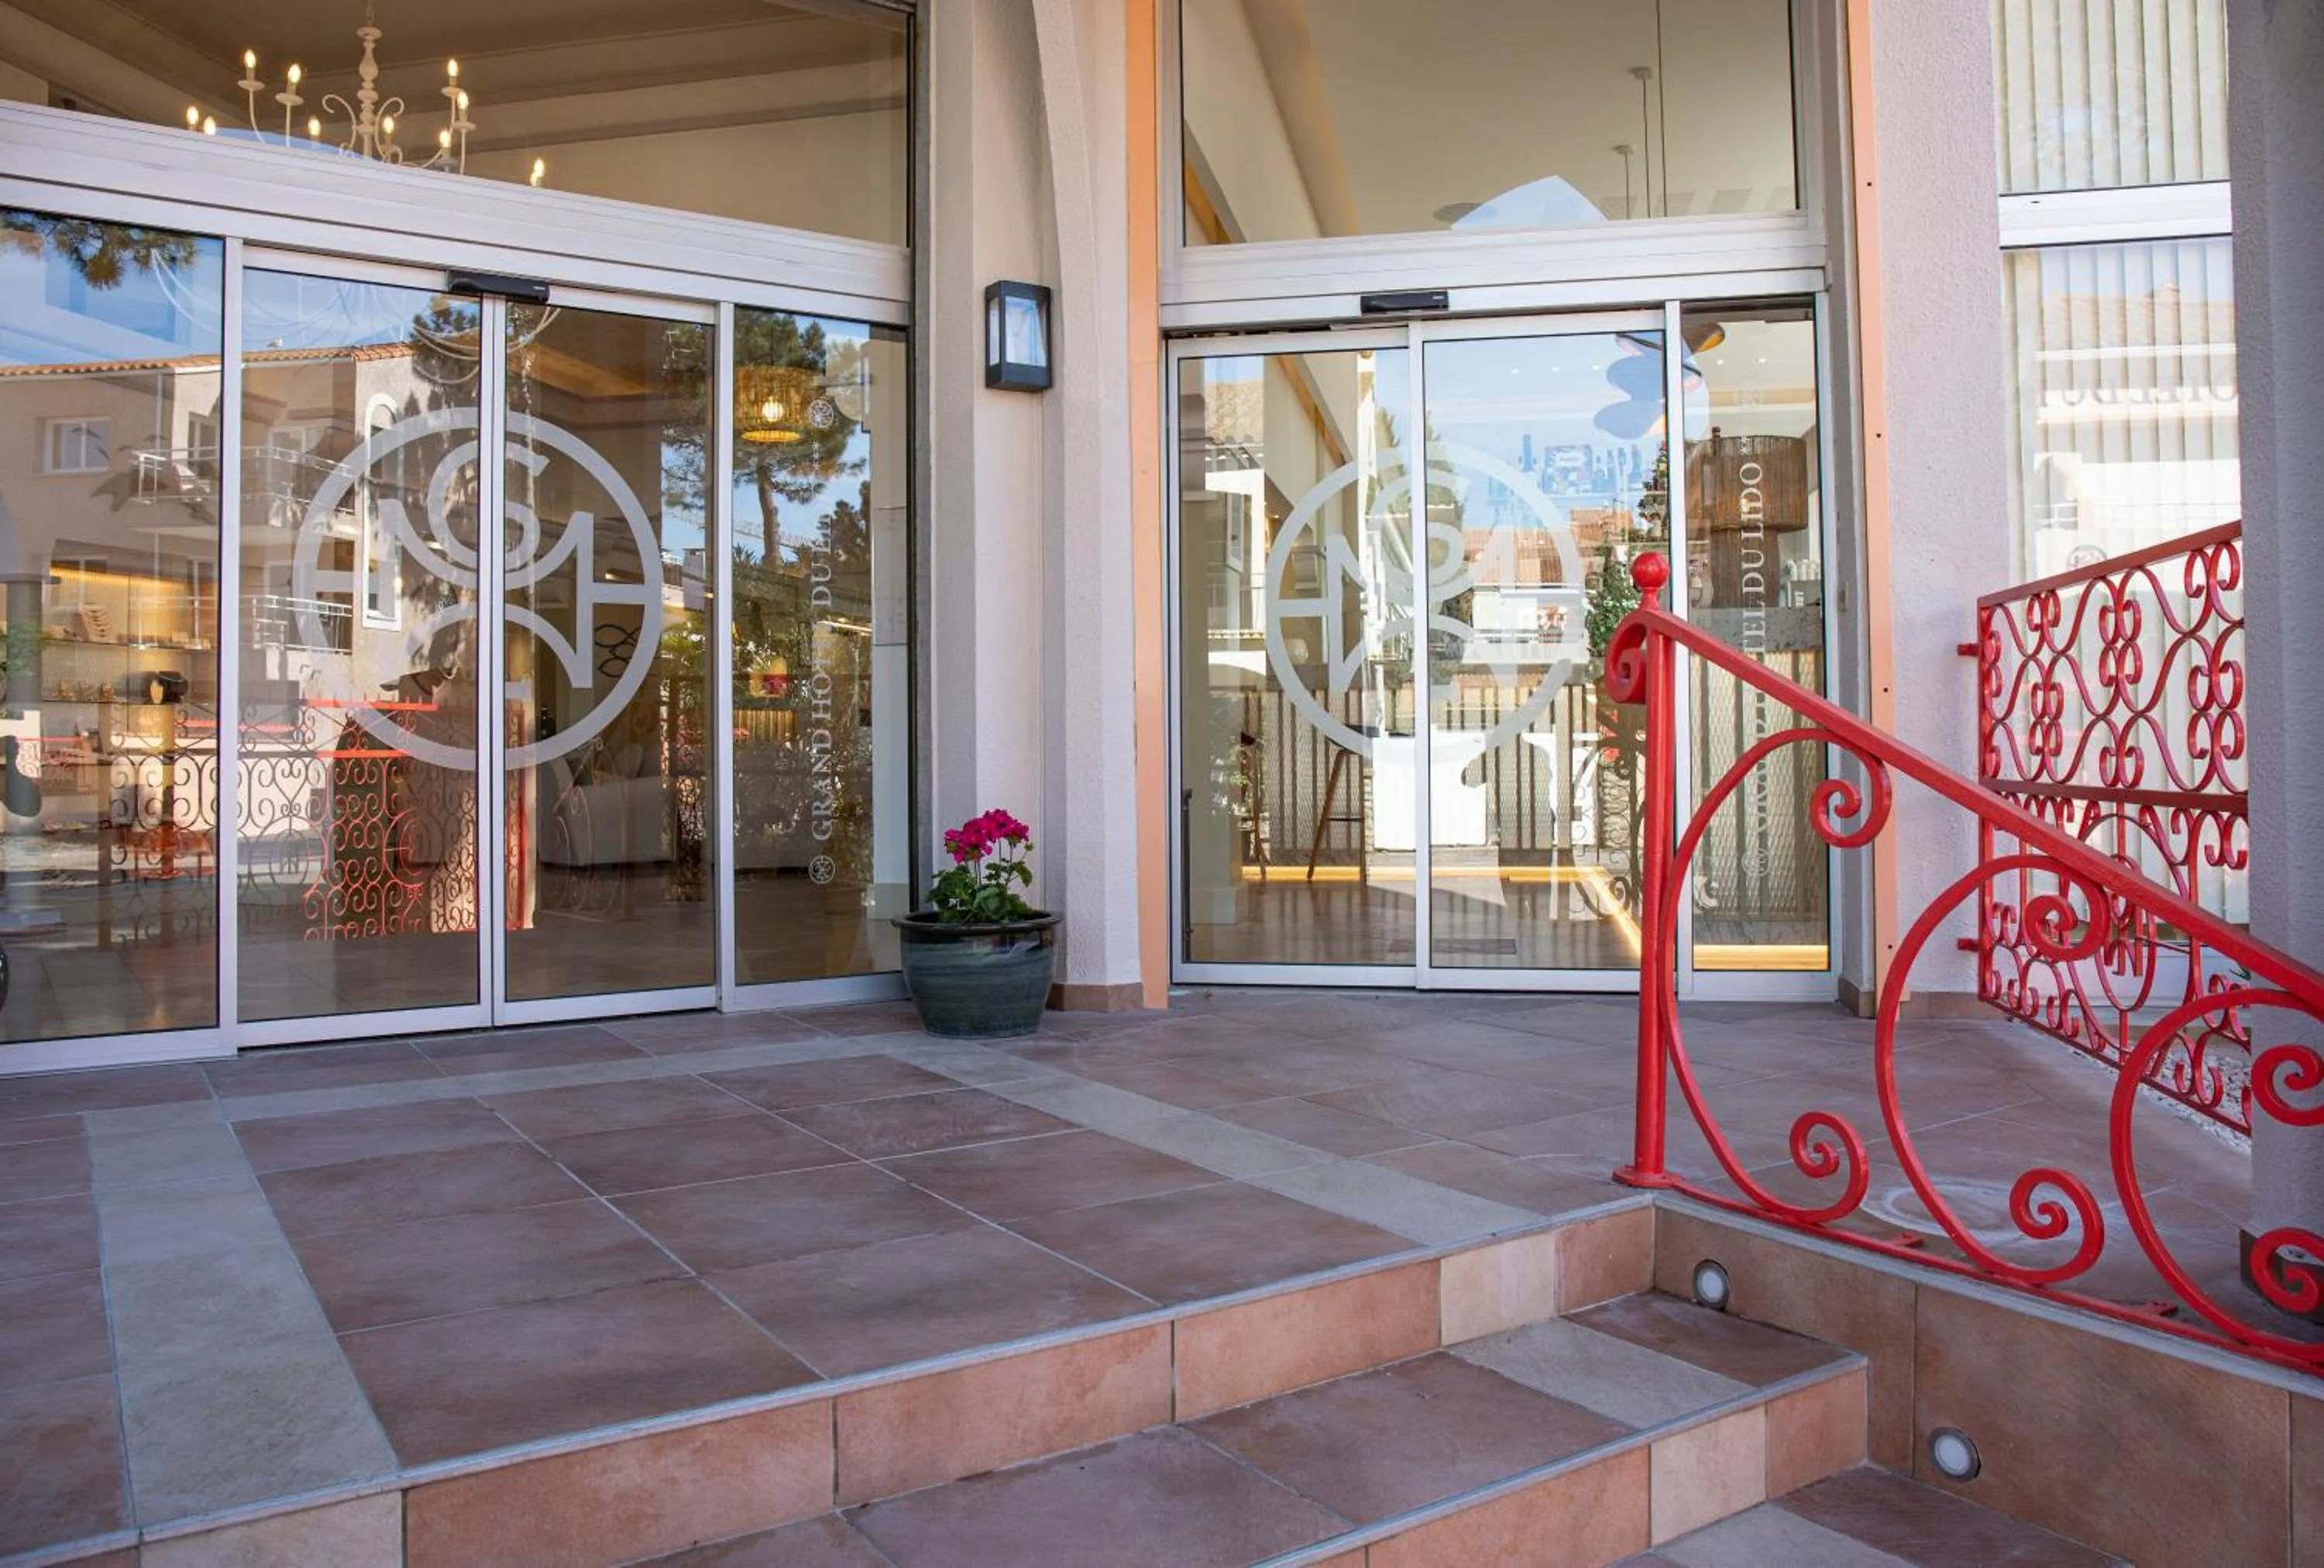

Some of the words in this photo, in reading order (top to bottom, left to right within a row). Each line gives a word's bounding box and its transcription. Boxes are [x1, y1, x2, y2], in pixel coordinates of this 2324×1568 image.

[1739, 462, 1763, 541] LIDO
[811, 563, 831, 607] DU
[1741, 548, 1765, 594] DU
[811, 729, 833, 841] GRAND
